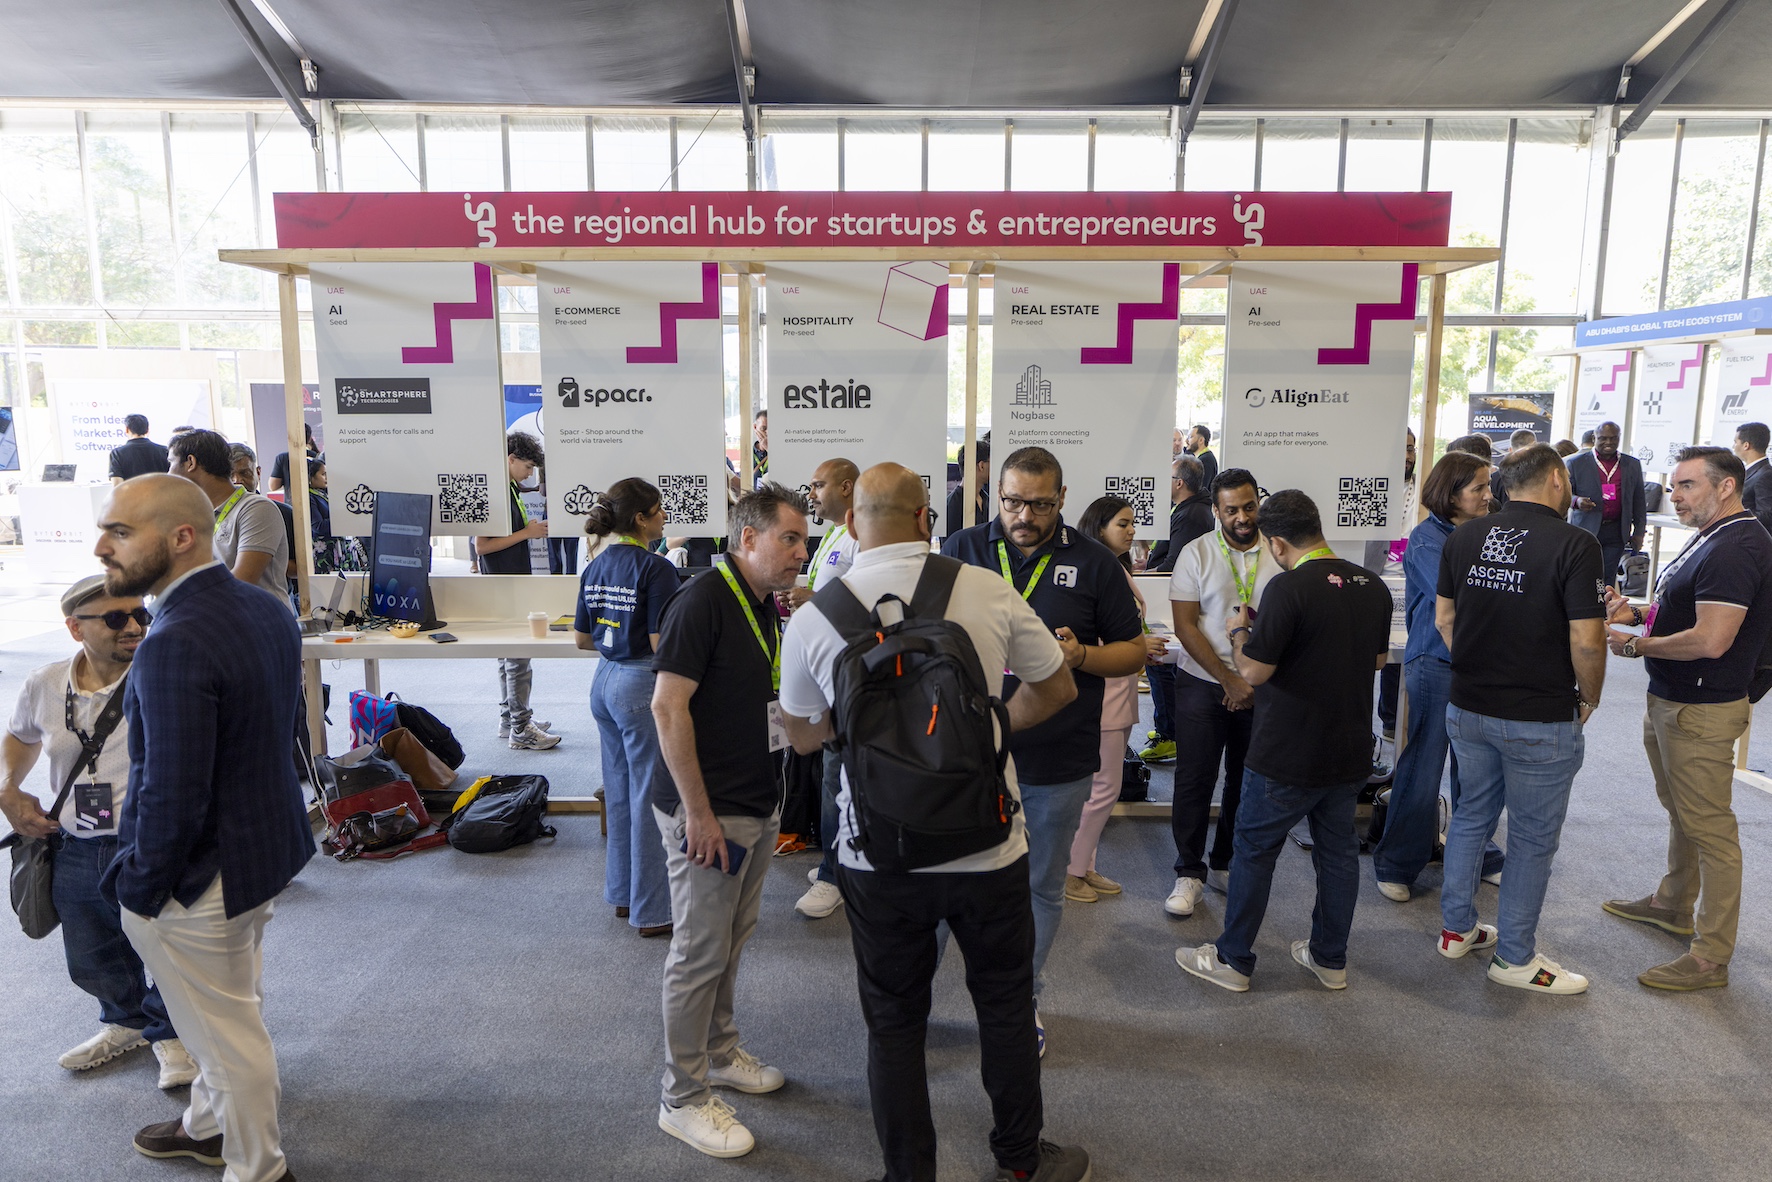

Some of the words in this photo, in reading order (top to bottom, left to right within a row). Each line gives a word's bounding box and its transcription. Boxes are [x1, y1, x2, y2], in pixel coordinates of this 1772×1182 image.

[512, 204, 564, 235] the
[574, 205, 697, 243] regional
[708, 205, 765, 235] hub
[774, 205, 818, 235] for
[827, 211, 957, 243] startups
[966, 209, 988, 235] &
[998, 211, 1217, 243] entrepreneurs
[329, 305, 342, 315] AI
[555, 307, 621, 315] E-COMMERCE
[1012, 305, 1046, 314] REAL
[1050, 305, 1100, 314] ESTATE
[1248, 307, 1261, 316] AI
[783, 317, 854, 326] HOSPITALITY
[1586, 328, 1600, 336] ABU
[1601, 325, 1630, 335] DHABI'S
[1631, 322, 1662, 332] GLOBAL
[1663, 319, 1684, 328] TECH
[1686, 312, 1743, 326] ECOSYSTEM
[584, 388, 653, 407] spacr.
[784, 378, 871, 408] estaie
[1270, 389, 1350, 408] AlignEat
[72, 416, 100, 424] From
[1010, 411, 1056, 421] Nogbase
[1468, 564, 1526, 584] ASCENT
[1466, 578, 1524, 593] ORIENTAL
